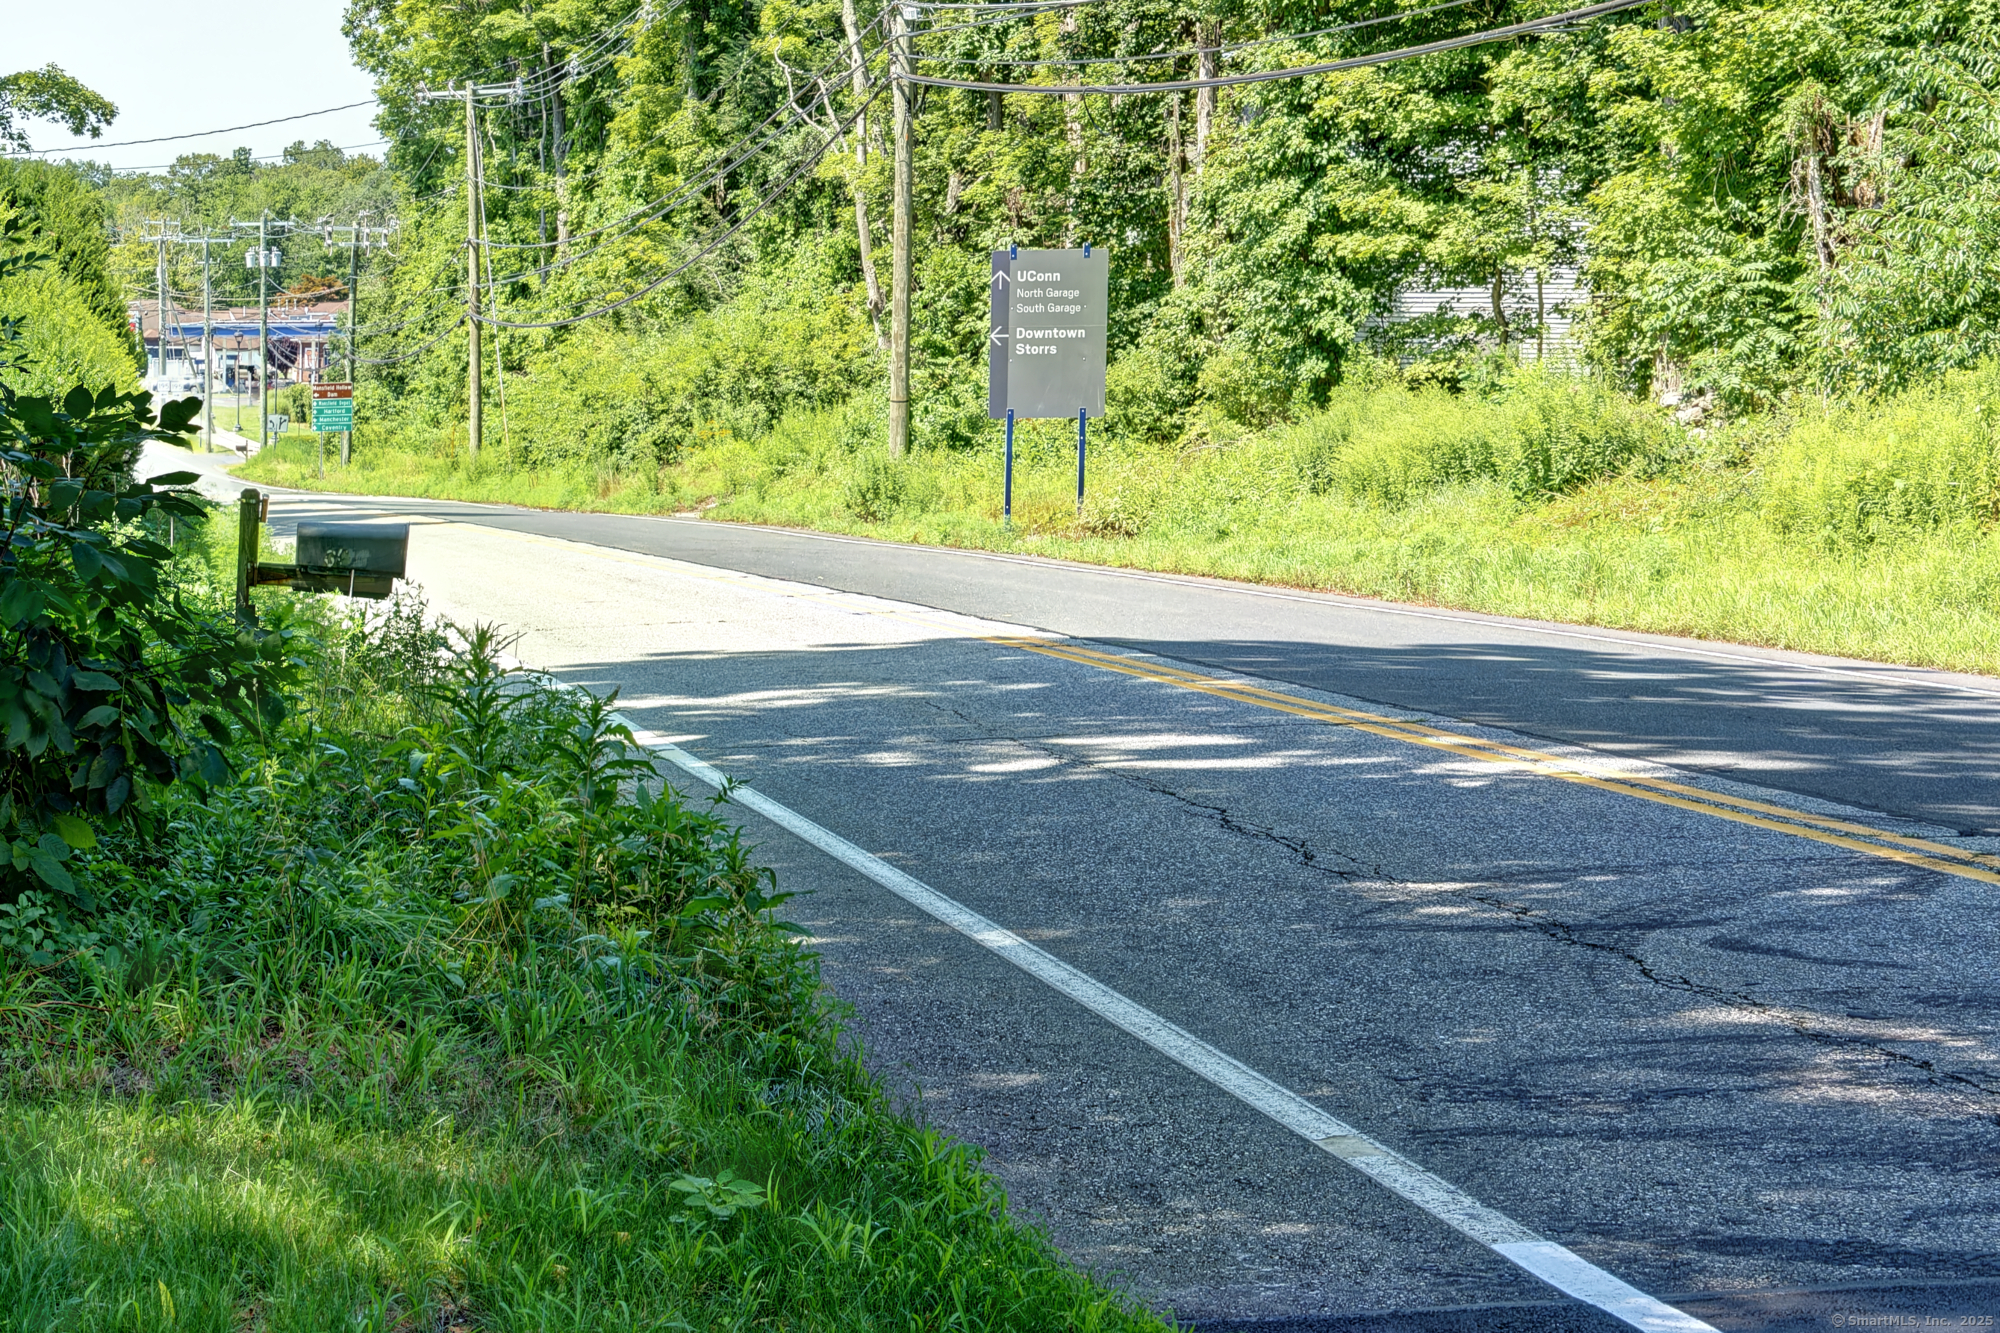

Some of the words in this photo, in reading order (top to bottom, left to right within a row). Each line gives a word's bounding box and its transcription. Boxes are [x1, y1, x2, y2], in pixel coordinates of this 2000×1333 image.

[1017, 270, 1061, 282] UConn
[1016, 288, 1044, 298] North
[1045, 288, 1080, 299] Garage
[1016, 303, 1045, 313] South
[1047, 303, 1081, 314] Garage
[1016, 327, 1086, 339] Downtown
[1015, 343, 1057, 355] Storrs
